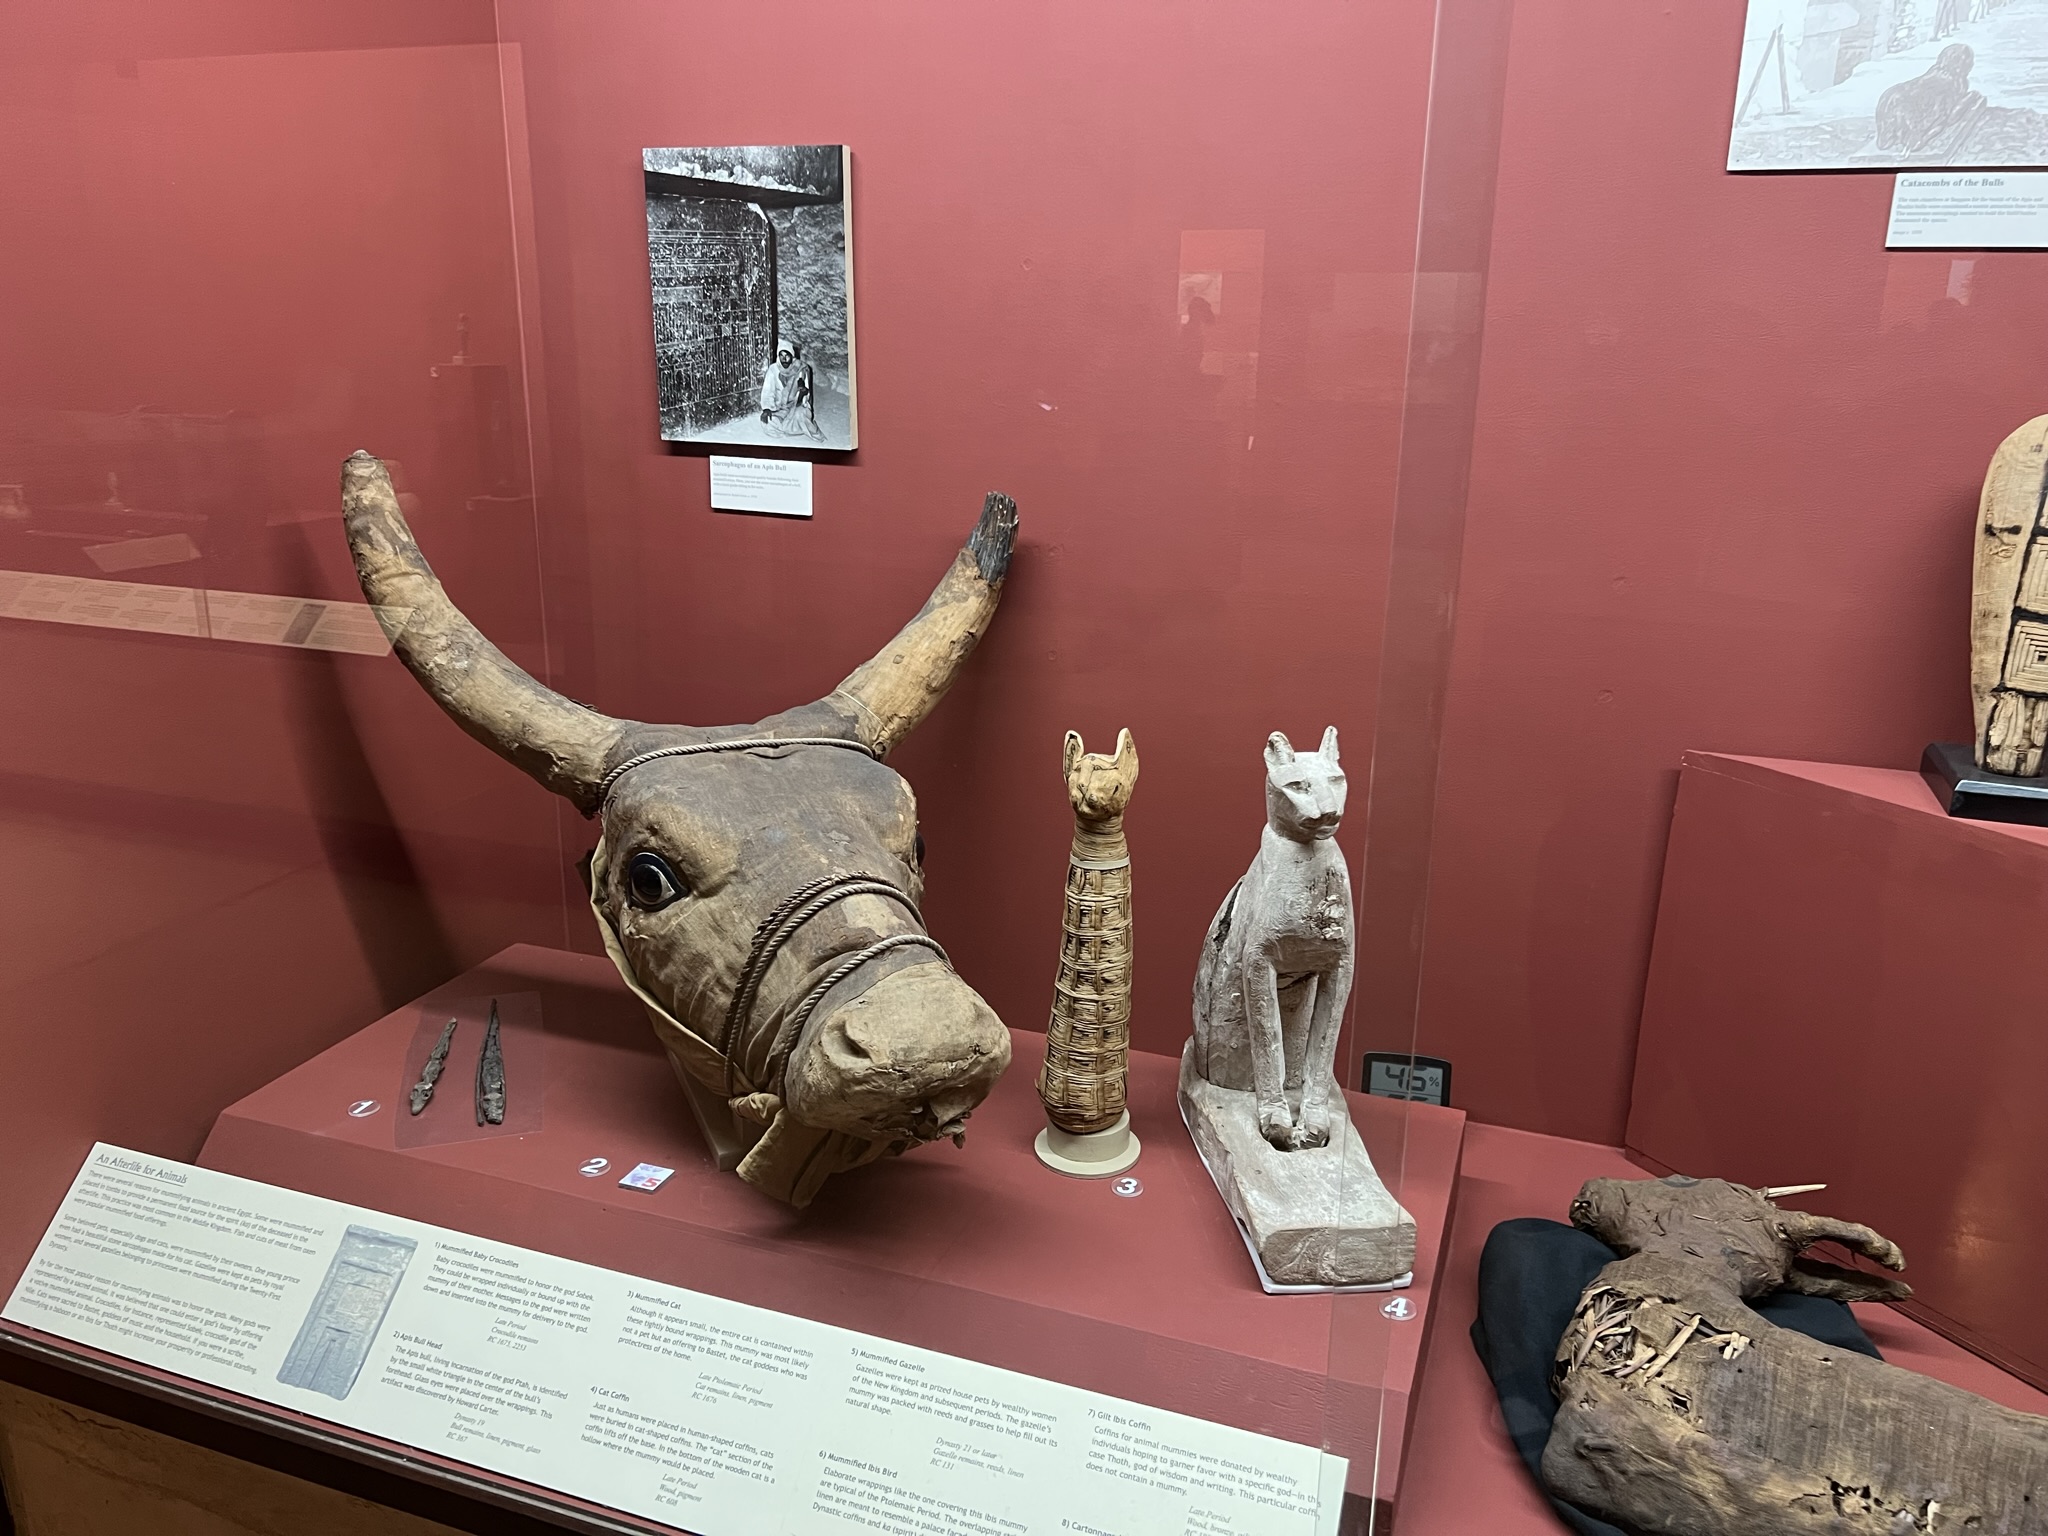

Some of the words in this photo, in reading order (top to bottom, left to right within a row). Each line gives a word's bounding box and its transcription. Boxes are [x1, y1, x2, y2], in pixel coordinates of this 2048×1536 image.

[1901, 178, 1950, 188] Catacombs
[1952, 178, 1964, 187] of
[1964, 178, 1979, 187] the
[1981, 178, 2004, 187] Bulls
[712, 460, 746, 469] Sarcophagus
[352, 1100, 374, 1114] 1
[97, 1153, 109, 1163] An
[111, 1158, 142, 1173] Afterlife
[143, 1164, 156, 1176] for
[157, 1168, 187, 1183] Animals
[580, 1157, 608, 1174] 2
[641, 1177, 661, 1188] 5
[1116, 1178, 1137, 1194] 3
[435, 1241, 441, 1249] 1)
[441, 1244, 474, 1257] Mummified
[473, 1251, 488, 1261] Baby
[488, 1255, 519, 1268] Crocodiles
[627, 1290, 634, 1299] 3)
[634, 1292, 670, 1307] Mummified
[670, 1301, 681, 1310] Cat
[1384, 1297, 1407, 1317] 4
[393, 1330, 400, 1339] 2)
[400, 1333, 413, 1342] Apis
[413, 1336, 426, 1345] Bull
[426, 1340, 443, 1350] Head
[630, 1305, 657, 1318] Although
[664, 1315, 688, 1326] appears
[709, 1326, 721, 1334] the
[721, 1330, 741, 1340] entire
[741, 1335, 753, 1343] cat
[760, 1340, 793, 1353] contained
[793, 1348, 814, 1358] within
[851, 1347, 859, 1357] 5)
[859, 1350, 898, 1366] Mummified
[899, 1360, 925, 1373] Gazelle
[381, 1377, 403, 1388] artifact
[415, 1386, 448, 1401] discovered
[447, 1395, 456, 1404] by
[455, 1397, 480, 1410] Howard
[590, 1386, 598, 1394] 4)
[598, 1387, 610, 1397] Cat
[610, 1391, 630, 1402] Coffin
[855, 1363, 884, 1377] Gazelles
[885, 1373, 902, 1382] were
[903, 1376, 919, 1387] kept
[929, 1384, 952, 1395] prized
[952, 1389, 973, 1400] house
[973, 1396, 990, 1405] pets
[991, 1398, 1000, 1409] by
[1002, 1403, 1030, 1417] wealthy
[1031, 1411, 1057, 1422] women
[861, 1377, 873, 1386] the
[874, 1380, 889, 1390] New
[890, 1384, 919, 1398] Kingdom
[920, 1393, 934, 1402] and
[934, 1397, 974, 1413] subsequent
[974, 1408, 1003, 1421] periods.
[1006, 1414, 1019, 1425] The
[1020, 1420, 1051, 1434] gazelle's
[845, 1398, 870, 1409] natural
[871, 1404, 891, 1415] shape.
[849, 1387, 876, 1400] mummy
[877, 1394, 890, 1403] was
[890, 1398, 917, 1410] packed
[917, 1405, 933, 1414] with
[934, 1409, 953, 1419] reeds
[954, 1415, 969, 1423] and
[969, 1419, 994, 1430] grasses
[996, 1425, 1004, 1433] to
[1005, 1427, 1022, 1438] help
[1023, 1431, 1033, 1441] fill
[1034, 1436, 1047, 1445] out
[1049, 1439, 1058, 1447] its
[1088, 1408, 1096, 1418] 7)
[1097, 1411, 1111, 1421] Gilt
[1113, 1415, 1126, 1425] Ibis
[1128, 1419, 1151, 1431] Coffin
[819, 1450, 827, 1460] 6)
[827, 1453, 867, 1470] Mummified
[867, 1464, 880, 1474] Ibis
[882, 1467, 898, 1478] Bird
[1092, 1438, 1131, 1454] individuals
[1132, 1447, 1158, 1463] hoping
[1159, 1456, 1168, 1464] to
[1169, 1459, 1195, 1471] garner
[1196, 1465, 1217, 1477] favor
[1218, 1472, 1236, 1482] with
[1245, 1479, 1275, 1493] specific
[1094, 1425, 1119, 1439] Coffins
[1121, 1432, 1133, 1442] for
[1133, 1437, 1160, 1449] animal
[1161, 1445, 1197, 1459] mummies
[1199, 1455, 1219, 1465] were
[1220, 1459, 1253, 1474] donated
[1254, 1467, 1264, 1478] by
[1266, 1472, 1298, 1487] wealthy
[1085, 1461, 1103, 1472] does
[1104, 1467, 1118, 1477] not
[1119, 1471, 1148, 1484] contain
[1156, 1481, 1187, 1496] mummy.
[1088, 1450, 1106, 1460] case
[1108, 1453, 1131, 1468] Thoth,
[1133, 1462, 1148, 1472] god
[1149, 1466, 1158, 1474] of
[1159, 1469, 1188, 1482] wisdom
[1189, 1477, 1205, 1487] and
[1206, 1482, 1236, 1496] writing.
[1239, 1488, 1255, 1501] This
[1256, 1495, 1297, 1511] particular
[823, 1466, 857, 1483] Elaborate
[858, 1478, 892, 1494] wrappings
[894, 1487, 907, 1498] like
[908, 1492, 921, 1501] the
[922, 1497, 936, 1506] one
[936, 1501, 968, 1517] covering
[969, 1509, 982, 1519] this
[984, 1513, 997, 1523] ibis
[998, 1519, 1028, 1532] mummy
[1061, 1518, 1070, 1529] 8)
